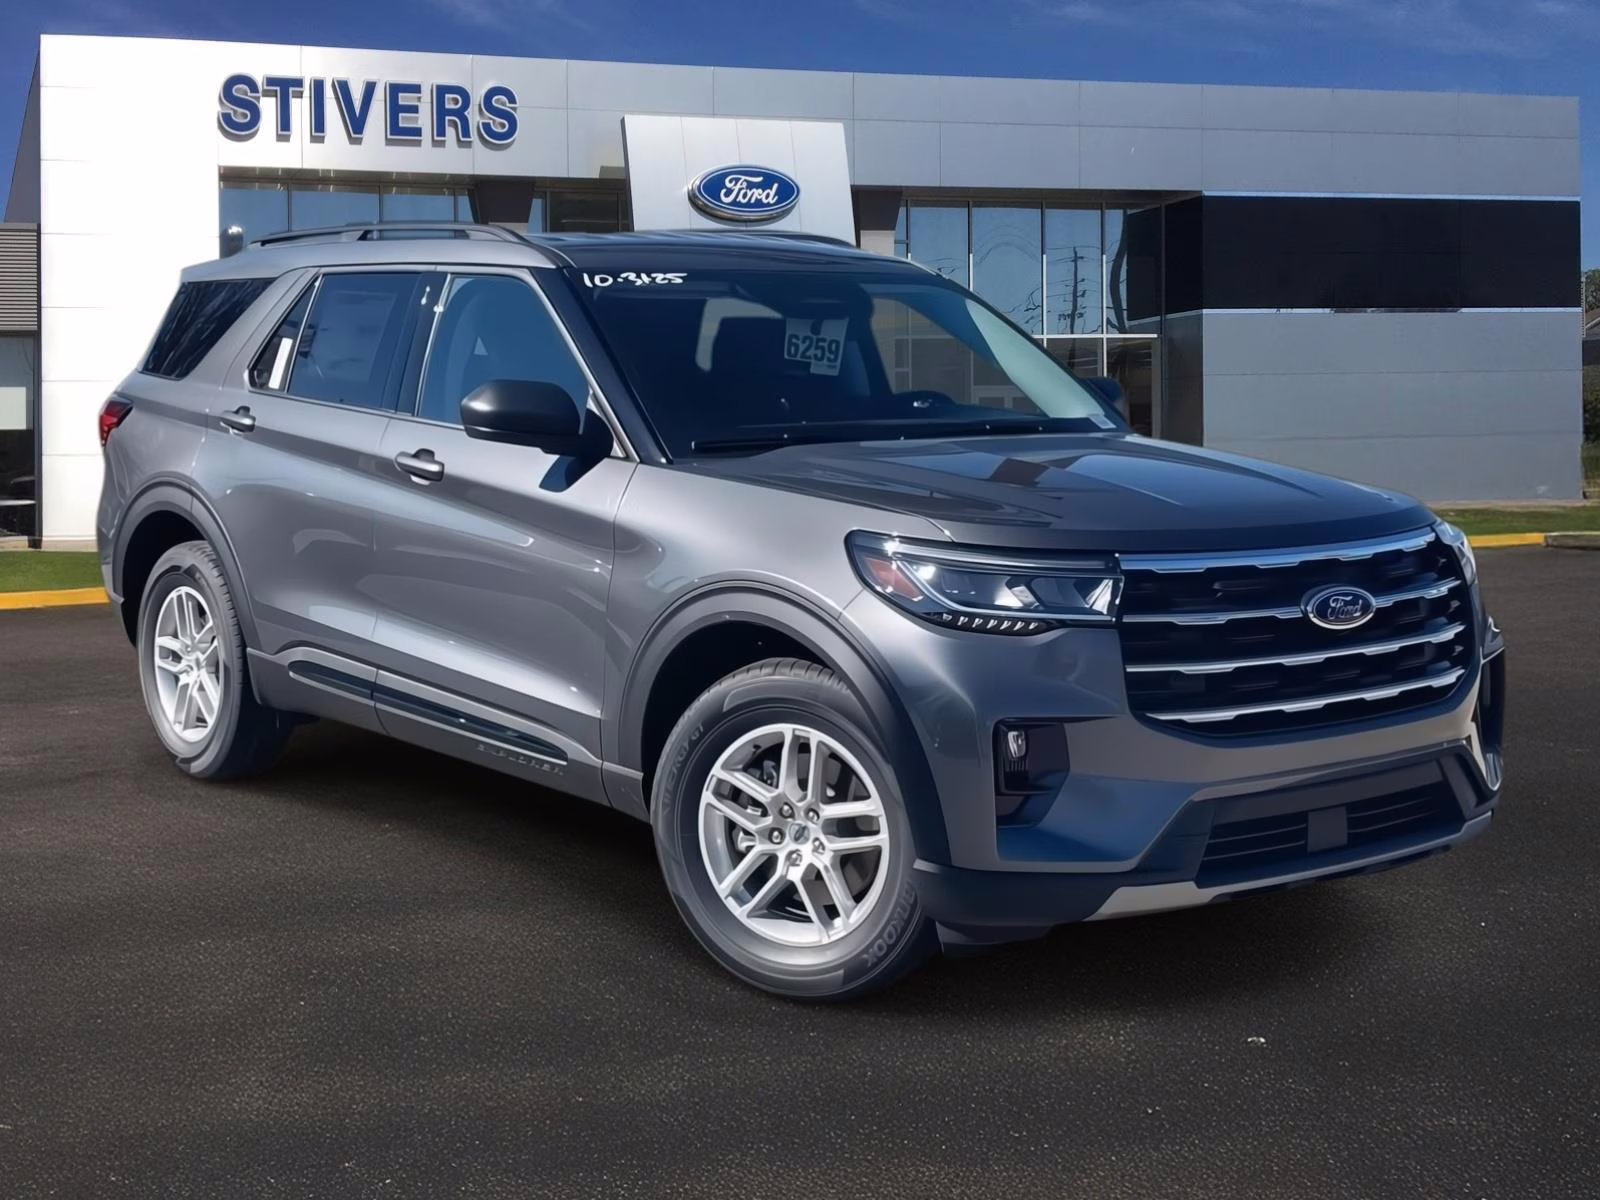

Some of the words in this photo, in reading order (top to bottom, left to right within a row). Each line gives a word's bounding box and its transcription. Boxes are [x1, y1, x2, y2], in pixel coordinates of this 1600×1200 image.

[218, 72, 519, 146] STIVERS
[720, 174, 779, 204] Ford
[786, 333, 840, 363] 6259
[1327, 595, 1363, 620] Ford
